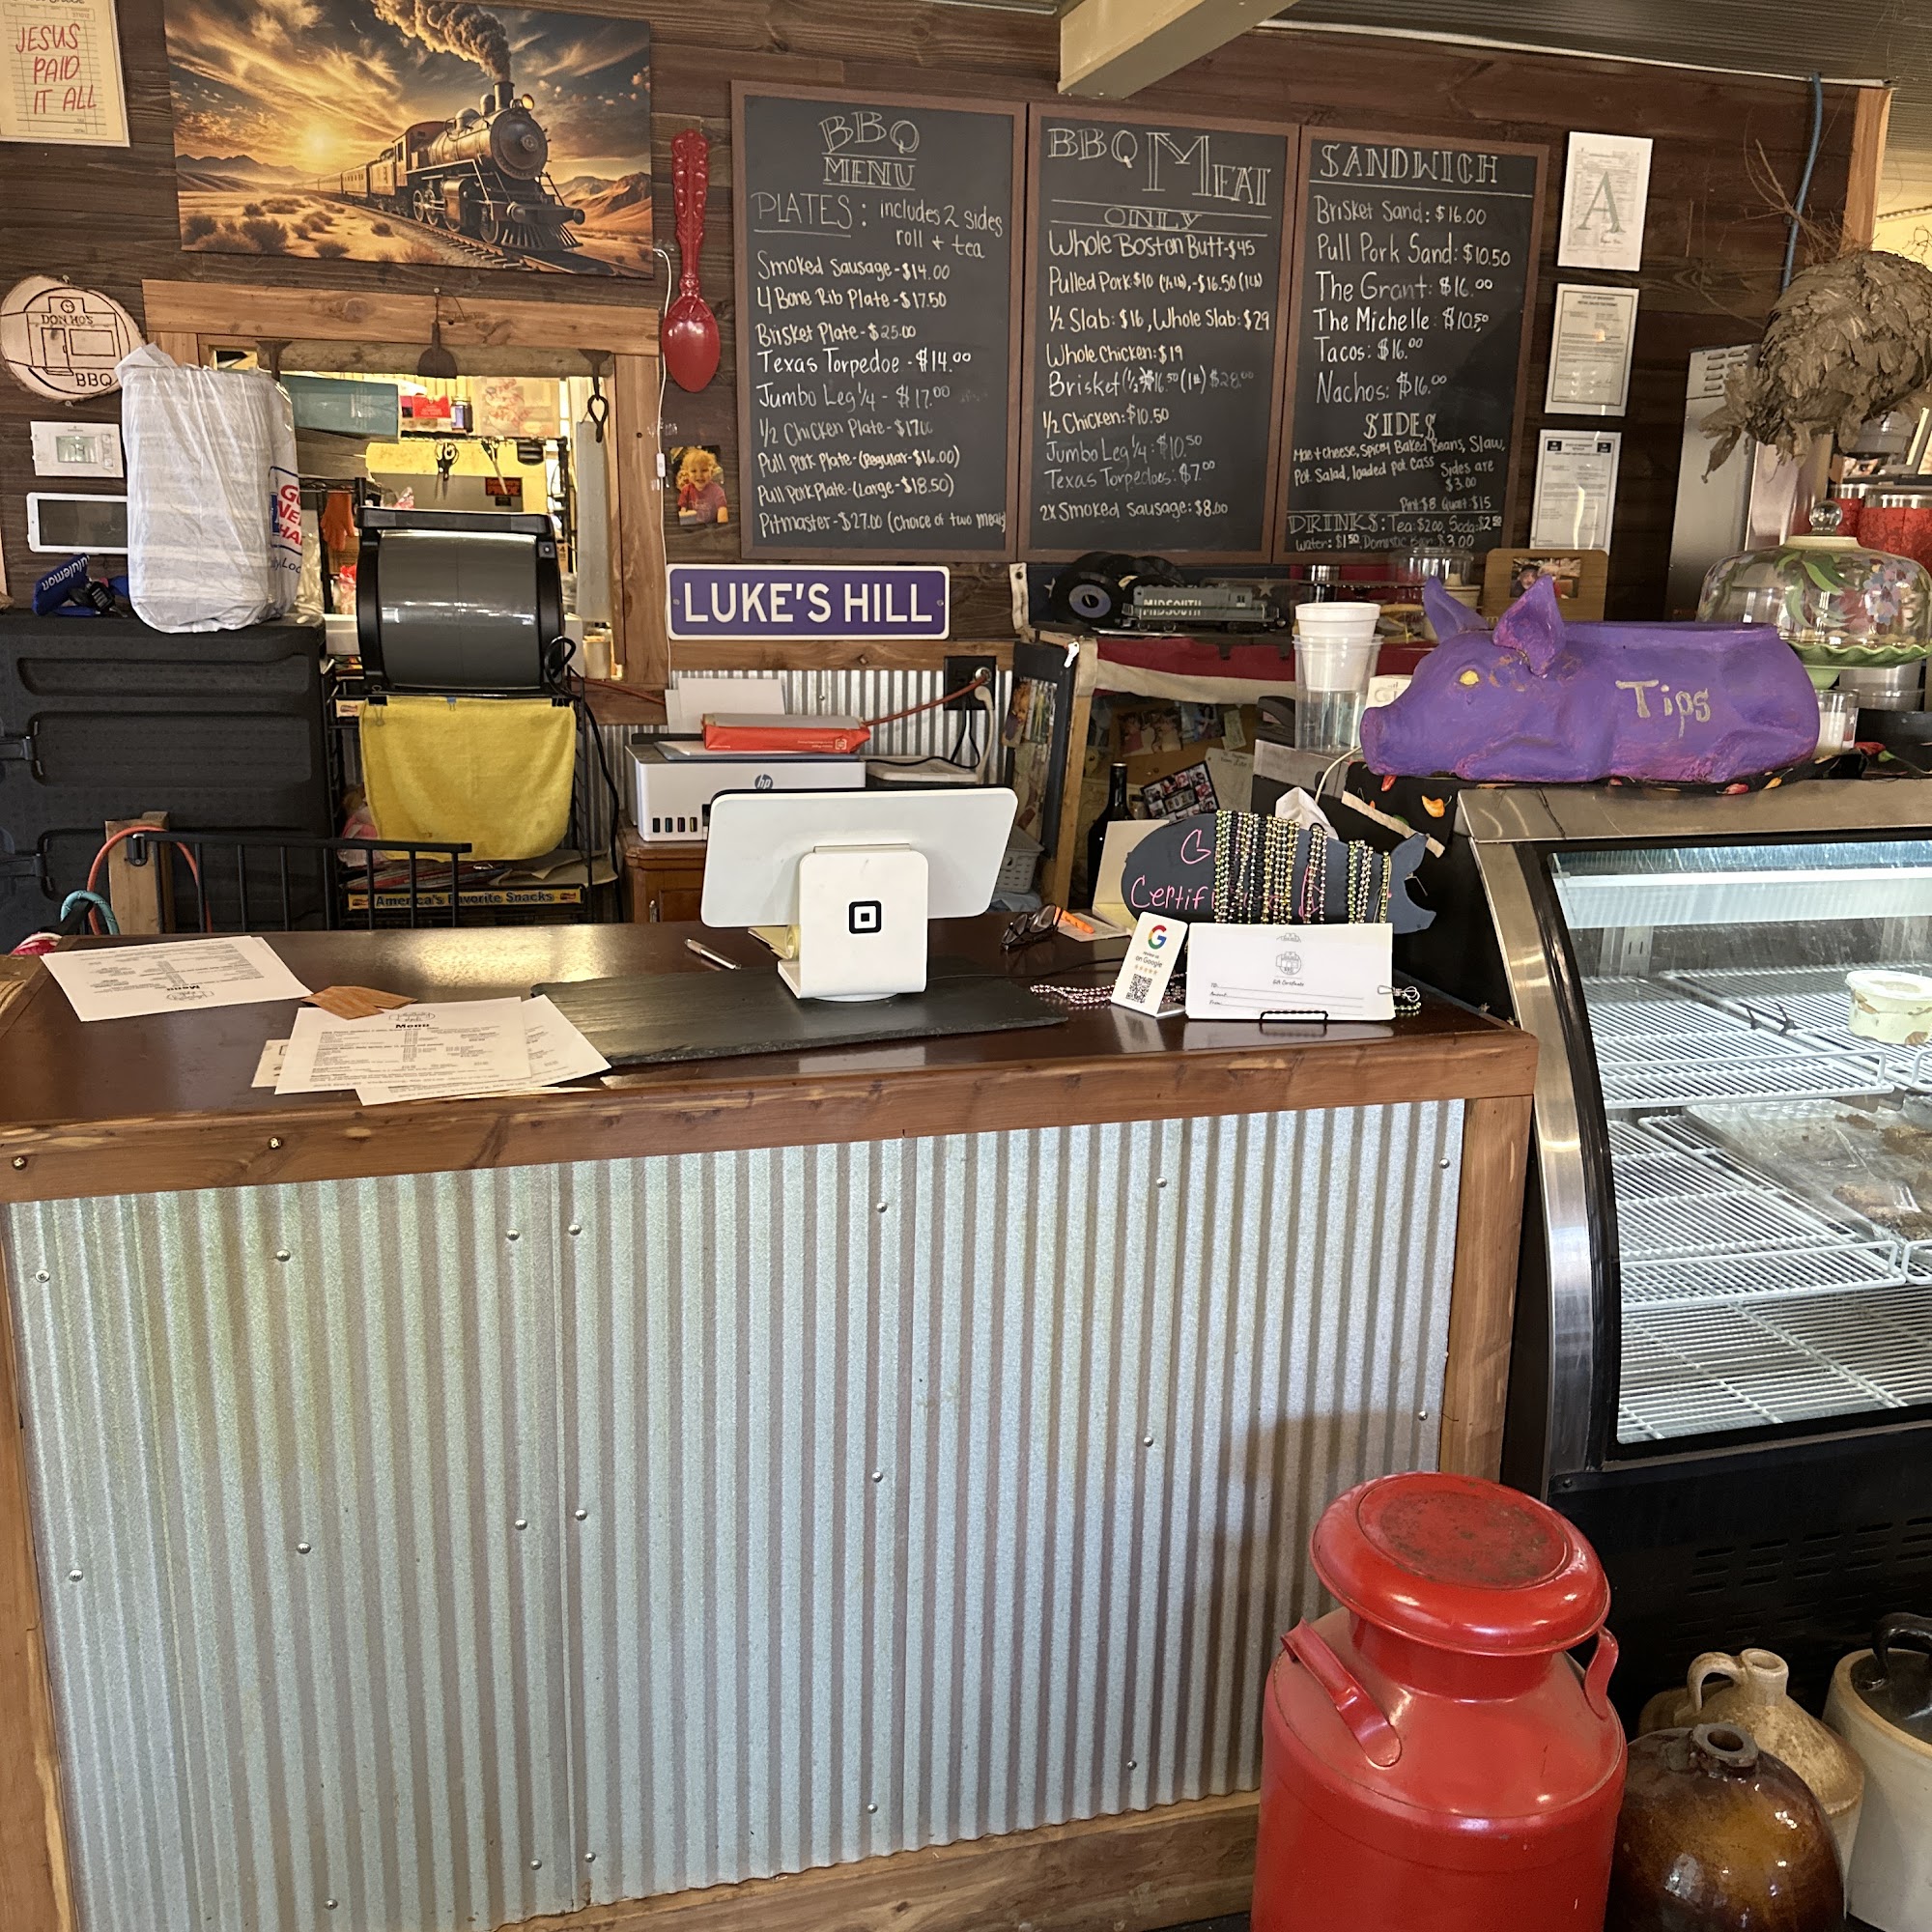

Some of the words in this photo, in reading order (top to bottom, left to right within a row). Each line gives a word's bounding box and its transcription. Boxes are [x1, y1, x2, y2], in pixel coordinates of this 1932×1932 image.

[15, 23, 80, 53] JESUS
[34, 55, 80, 85] PAID
[34, 89, 53, 115] IT
[63, 84, 97, 112] ALL
[818, 111, 920, 154] BBQ
[823, 156, 915, 187] MENU
[1047, 128, 1139, 169] BBQ
[1142, 131, 1271, 206] MEAT
[1320, 144, 1498, 184] SANDWICH
[1314, 194, 1373, 225] Brisket
[1435, 204, 1487, 225] $16.00
[1575, 171, 1627, 233] A
[880, 199, 941, 225] includes
[945, 206, 958, 227] 2
[965, 210, 1003, 237] sides
[1104, 207, 1203, 231] ONLY
[896, 229, 923, 247] roll
[952, 235, 985, 258] tea
[1048, 229, 1112, 257] Whole
[1113, 233, 1184, 258] Boston
[1317, 233, 1351, 262] Pull
[1360, 232, 1401, 264] Pork
[1463, 242, 1511, 267] $10.50
[757, 250, 823, 280] Smoked
[1049, 266, 1096, 297] Pulled
[1315, 270, 1352, 301] The
[757, 286, 772, 314] 4
[775, 288, 812, 310] Bone
[815, 288, 843, 306] Rib
[41, 315, 67, 325] DON
[1153, 307, 1202, 330] Whole
[1243, 309, 1269, 330] $29
[1313, 308, 1349, 332] The
[755, 322, 813, 347] Brisket
[757, 350, 818, 374] Texas
[823, 347, 899, 378] Torpedoe
[1046, 343, 1095, 368] Whole
[1158, 345, 1183, 364] $19
[75, 373, 112, 386] BBQ
[1049, 370, 1121, 397] Brisket
[755, 383, 817, 408] Jumbo
[823, 384, 856, 412] Leg
[1126, 403, 1170, 425] $10.50
[1363, 412, 1436, 441] SIDES
[783, 418, 844, 447] Chicken
[1394, 439, 1427, 454] Baked
[757, 452, 786, 478] Pull
[789, 454, 817, 474] Pork
[1046, 440, 1098, 464] Jumbo
[1101, 438, 1129, 470] Leg
[1440, 459, 1471, 477] Sides
[1474, 460, 1494, 472] are
[1044, 469, 1096, 490] Texas
[757, 485, 785, 507] Pull
[787, 484, 814, 504] Pork
[1059, 502, 1120, 522] Smoked
[1195, 498, 1229, 518] $8.00
[934, 513, 945, 526] of
[950, 512, 973, 526] two
[684, 582, 832, 623] LUKE'S
[844, 582, 932, 622] HILL
[1615, 679, 1711, 739] Tips
[754, 774, 773, 789] hp
[376, 894, 443, 907] Amerca's
[506, 891, 554, 902] Snacks
[1148, 924, 1167, 951] G
[1143, 956, 1163, 968] Google
